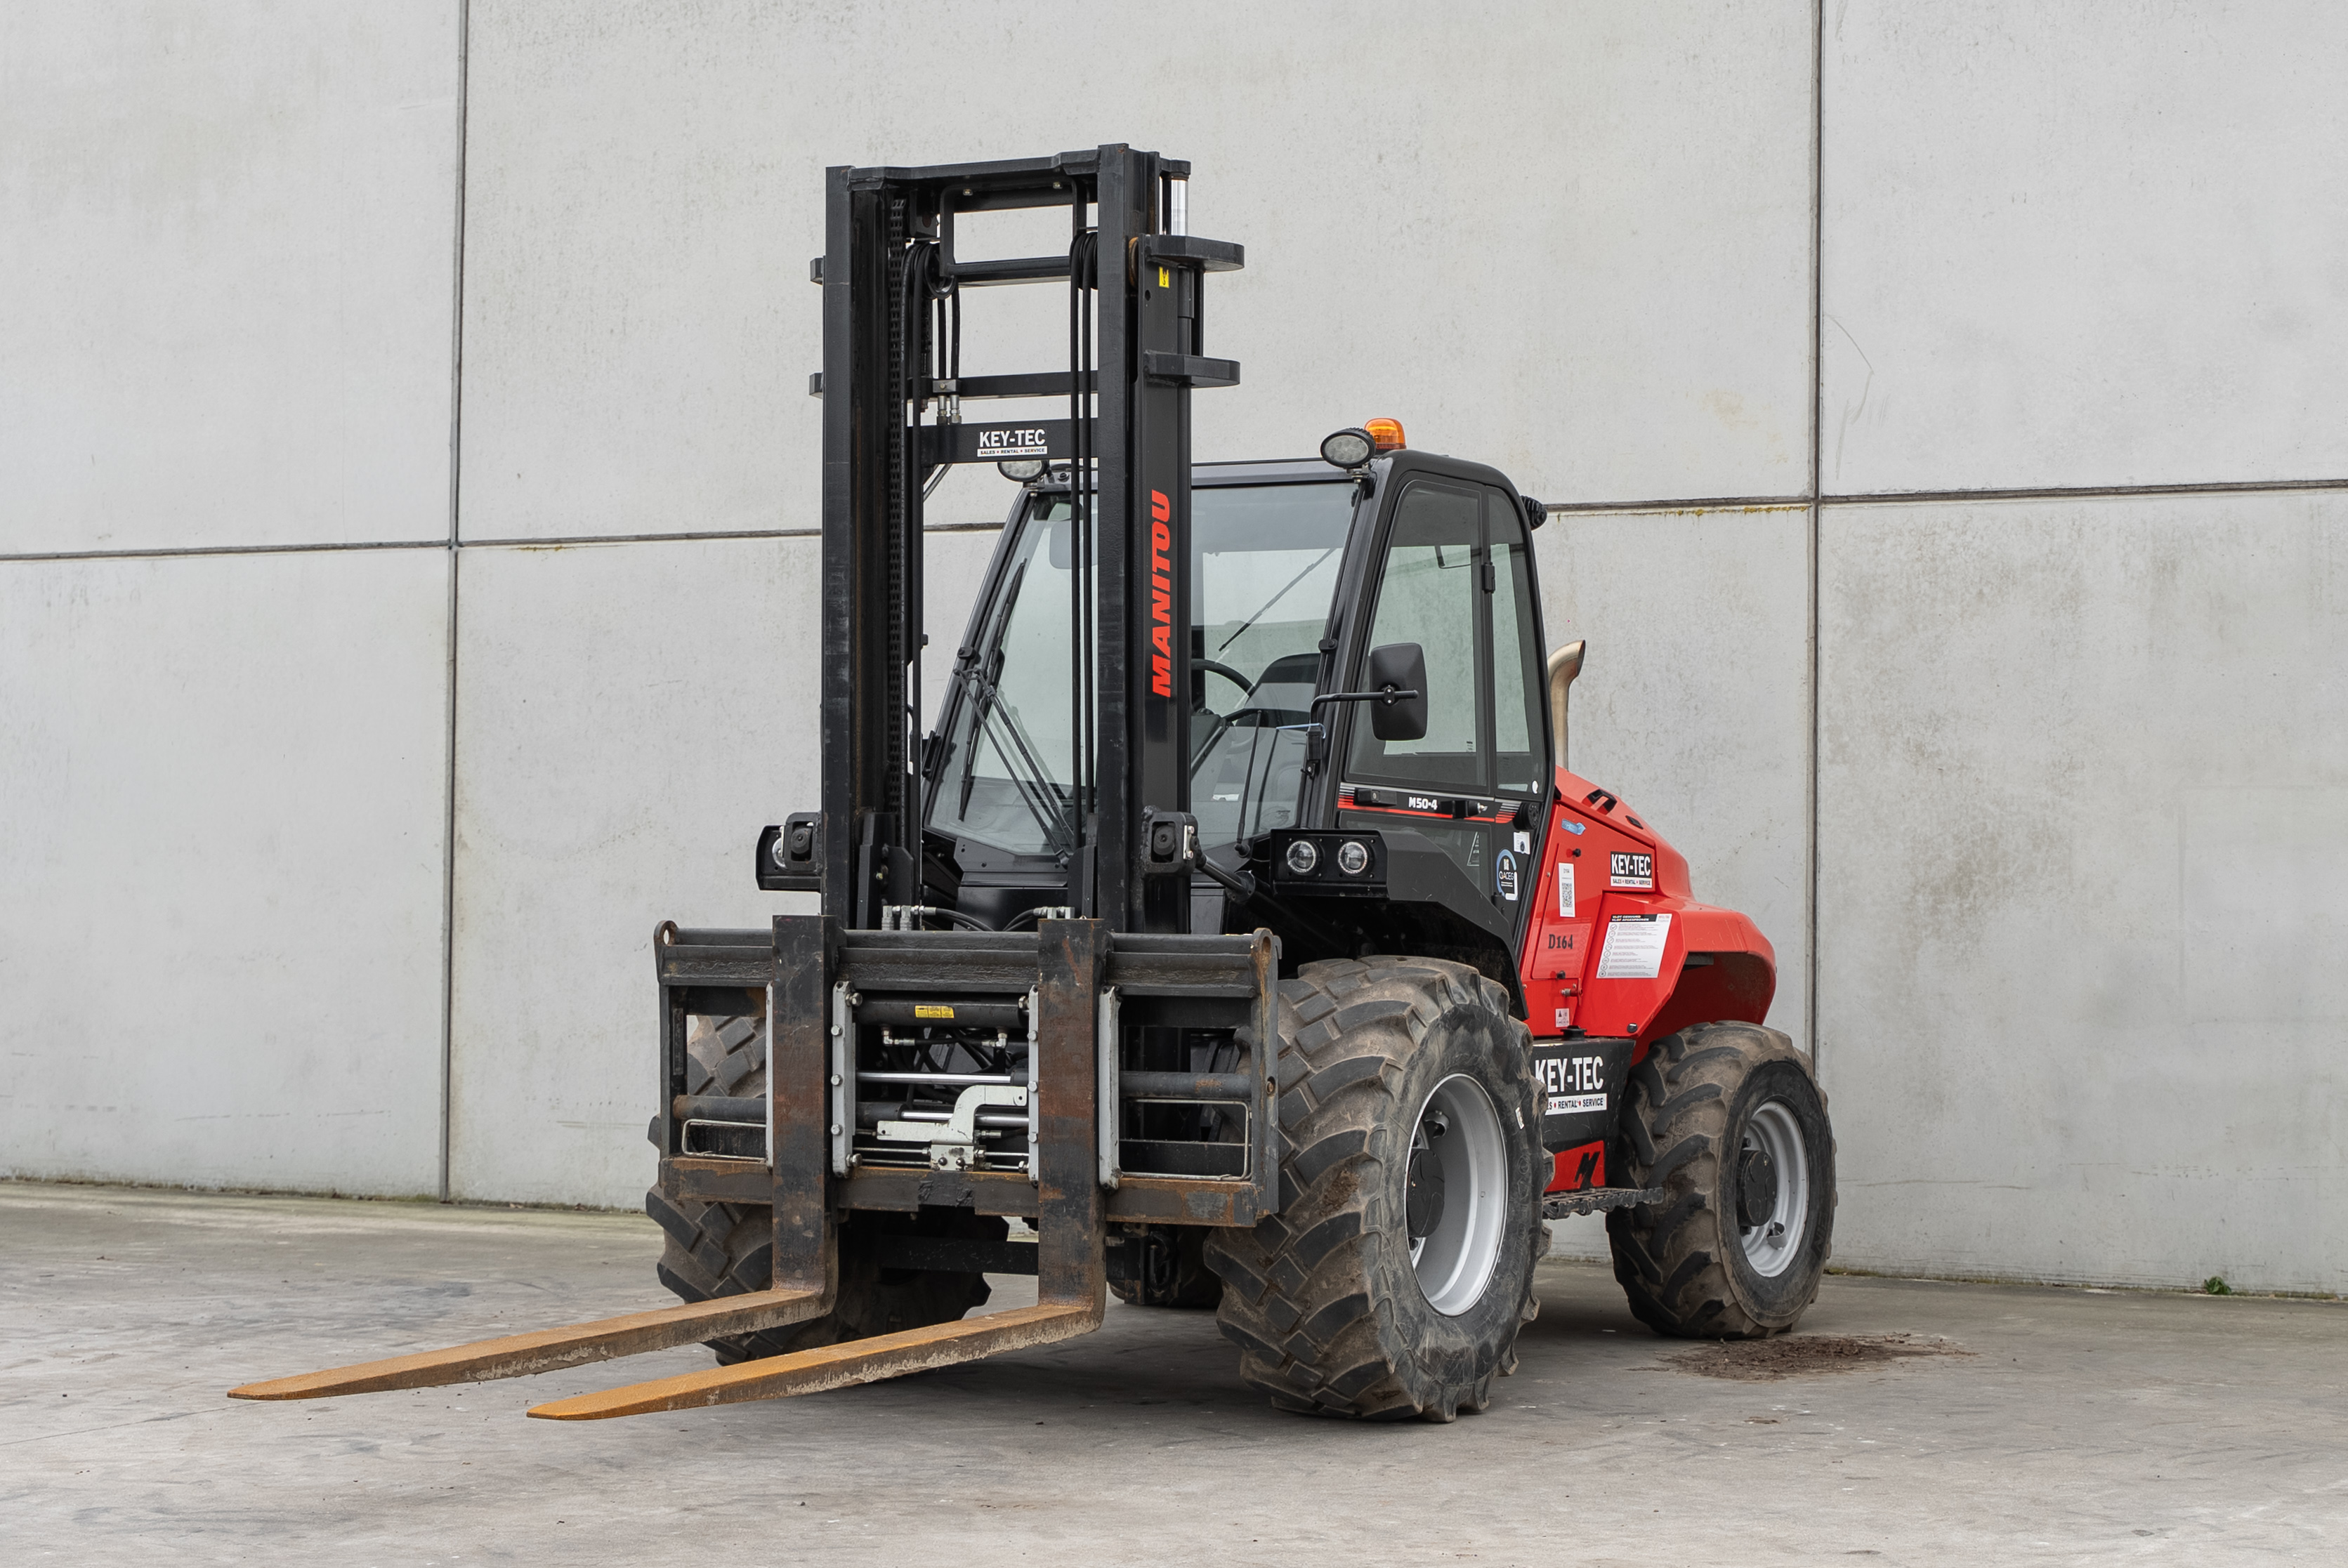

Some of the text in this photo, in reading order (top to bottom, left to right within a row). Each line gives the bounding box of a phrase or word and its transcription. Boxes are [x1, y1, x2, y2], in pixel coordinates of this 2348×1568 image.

[980, 429, 1046, 447] KEY-TEC
[1152, 489, 1171, 697] MANITOU
[1611, 854, 1651, 876] KEY-TEC
[1548, 934, 1573, 949] D164
[1535, 1056, 1604, 1093] KEY-TEC
[1558, 1100, 1578, 1109] RENTAL
[1582, 1098, 1603, 1107] SERVICE
